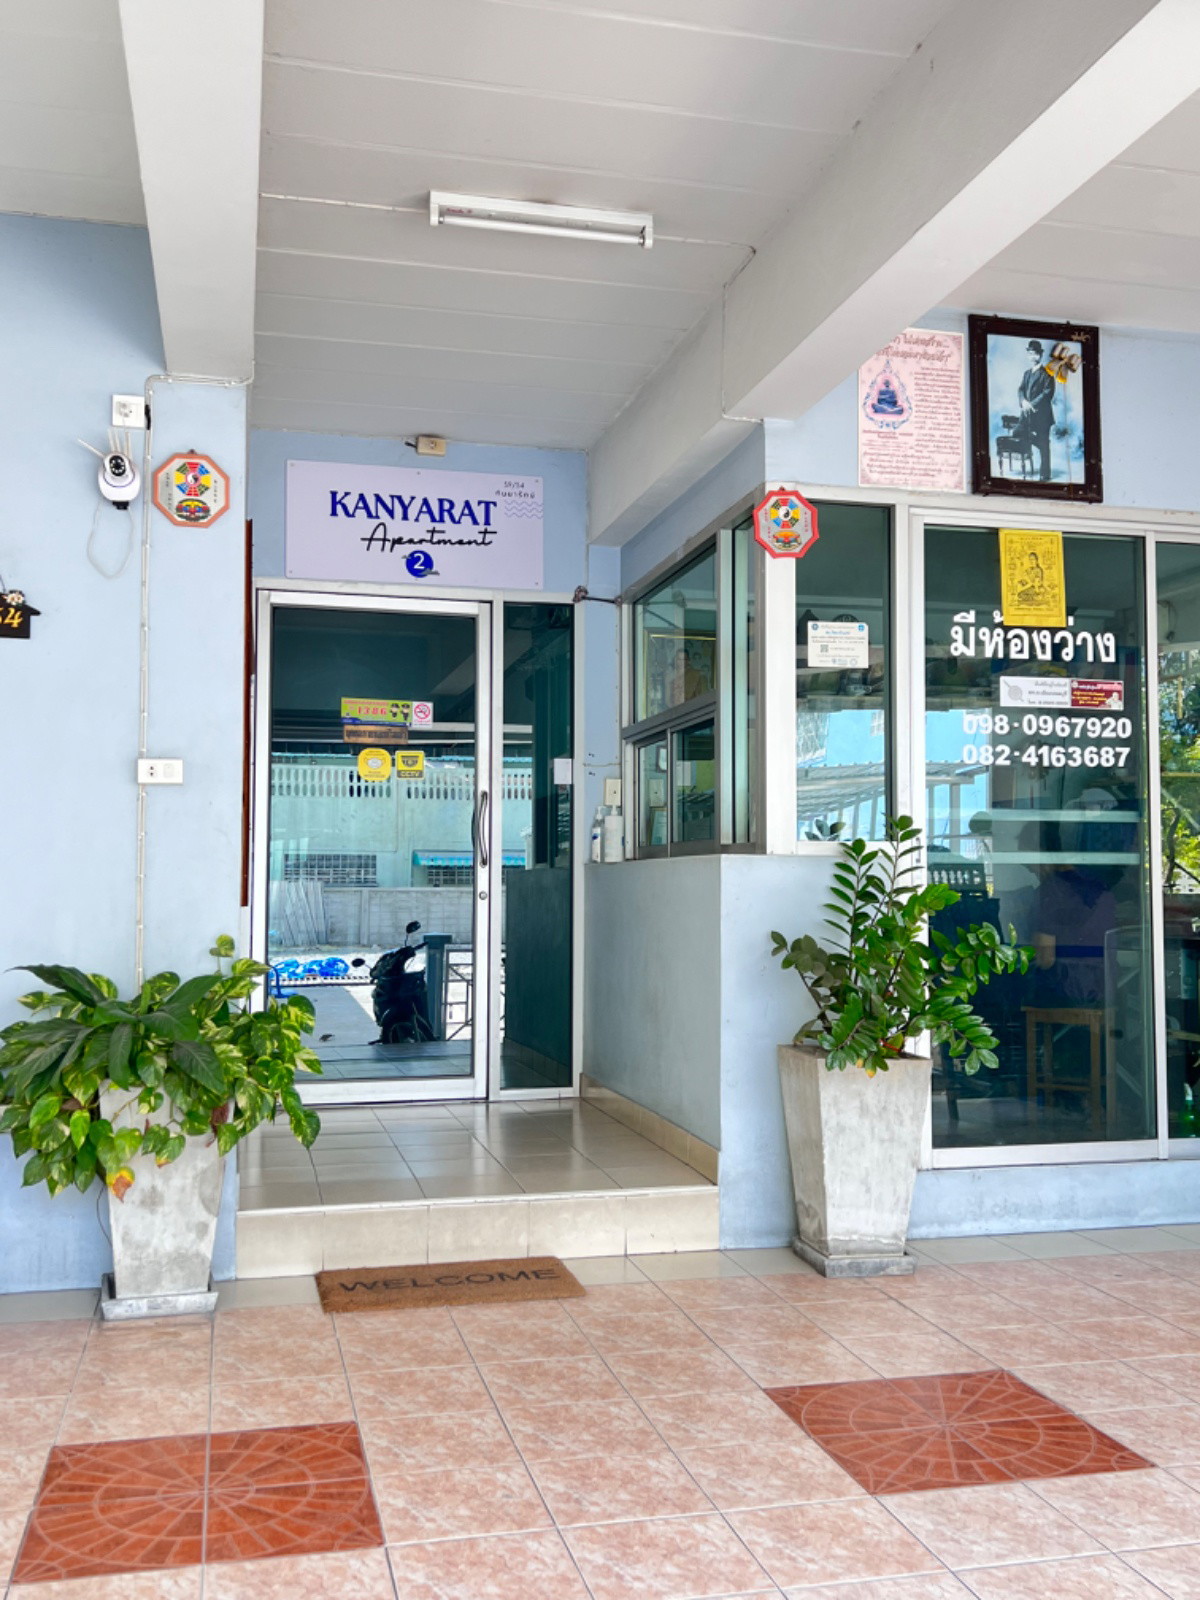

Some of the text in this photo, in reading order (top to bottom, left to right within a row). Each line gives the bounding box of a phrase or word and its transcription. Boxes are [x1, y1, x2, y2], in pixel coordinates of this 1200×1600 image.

[329, 490, 497, 526] KANYARAT
[360, 522, 497, 553] Apartment
[413, 553, 425, 570] 2
[950, 609, 1117, 663] มีห้องว่าง
[339, 1268, 562, 1292] WELCOME
